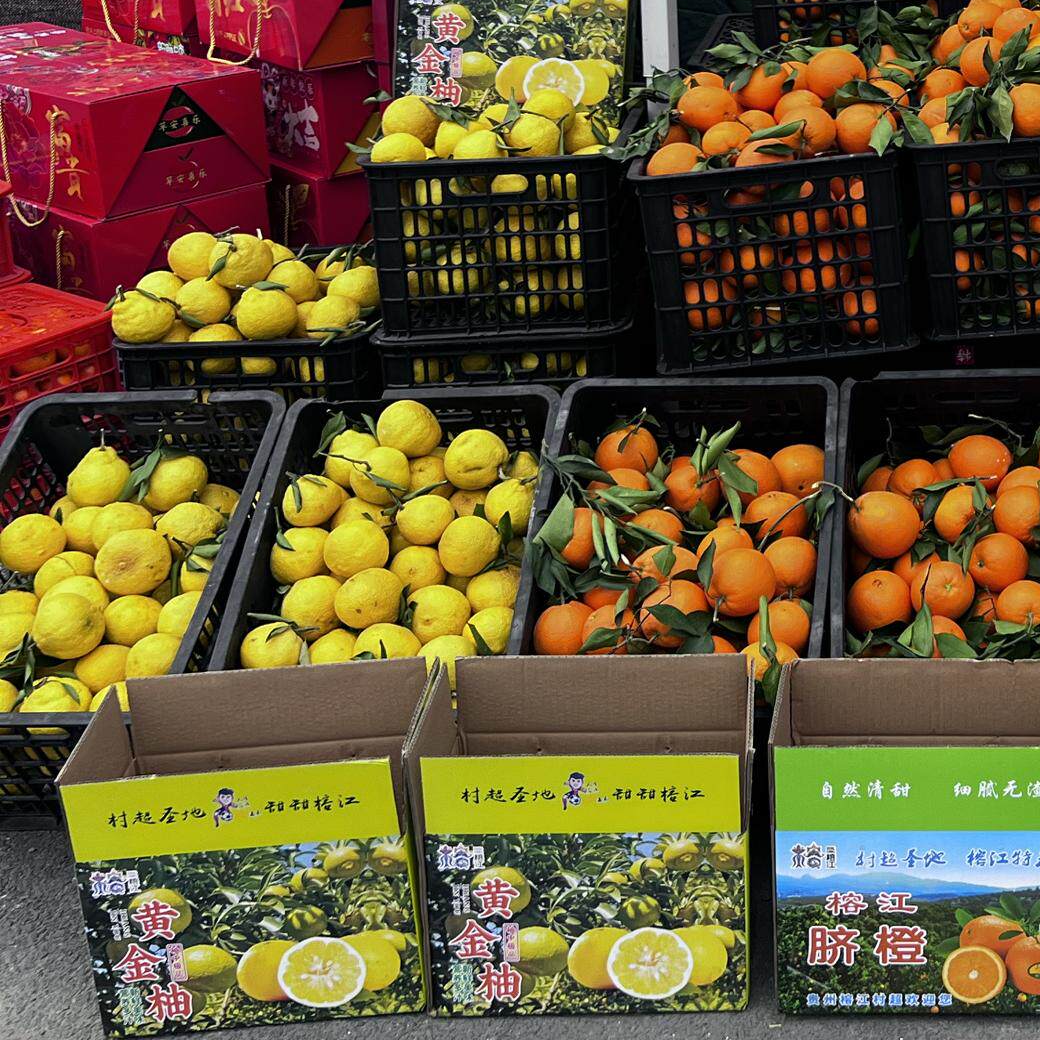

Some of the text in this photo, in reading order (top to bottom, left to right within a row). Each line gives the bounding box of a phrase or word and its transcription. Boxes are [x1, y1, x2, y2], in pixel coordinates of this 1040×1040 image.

[413, 13, 465, 106] 黄金柚
[461, 787, 556, 805] 村超圣地
[821, 780, 912, 799] 自然清甜
[106, 806, 207, 829] 村超圣地
[825, 891, 918, 916] 榕江
[449, 877, 522, 1002] 黄金柚
[807, 925, 927, 966] 脐橙
[112, 899, 193, 1022] 黄金柚
